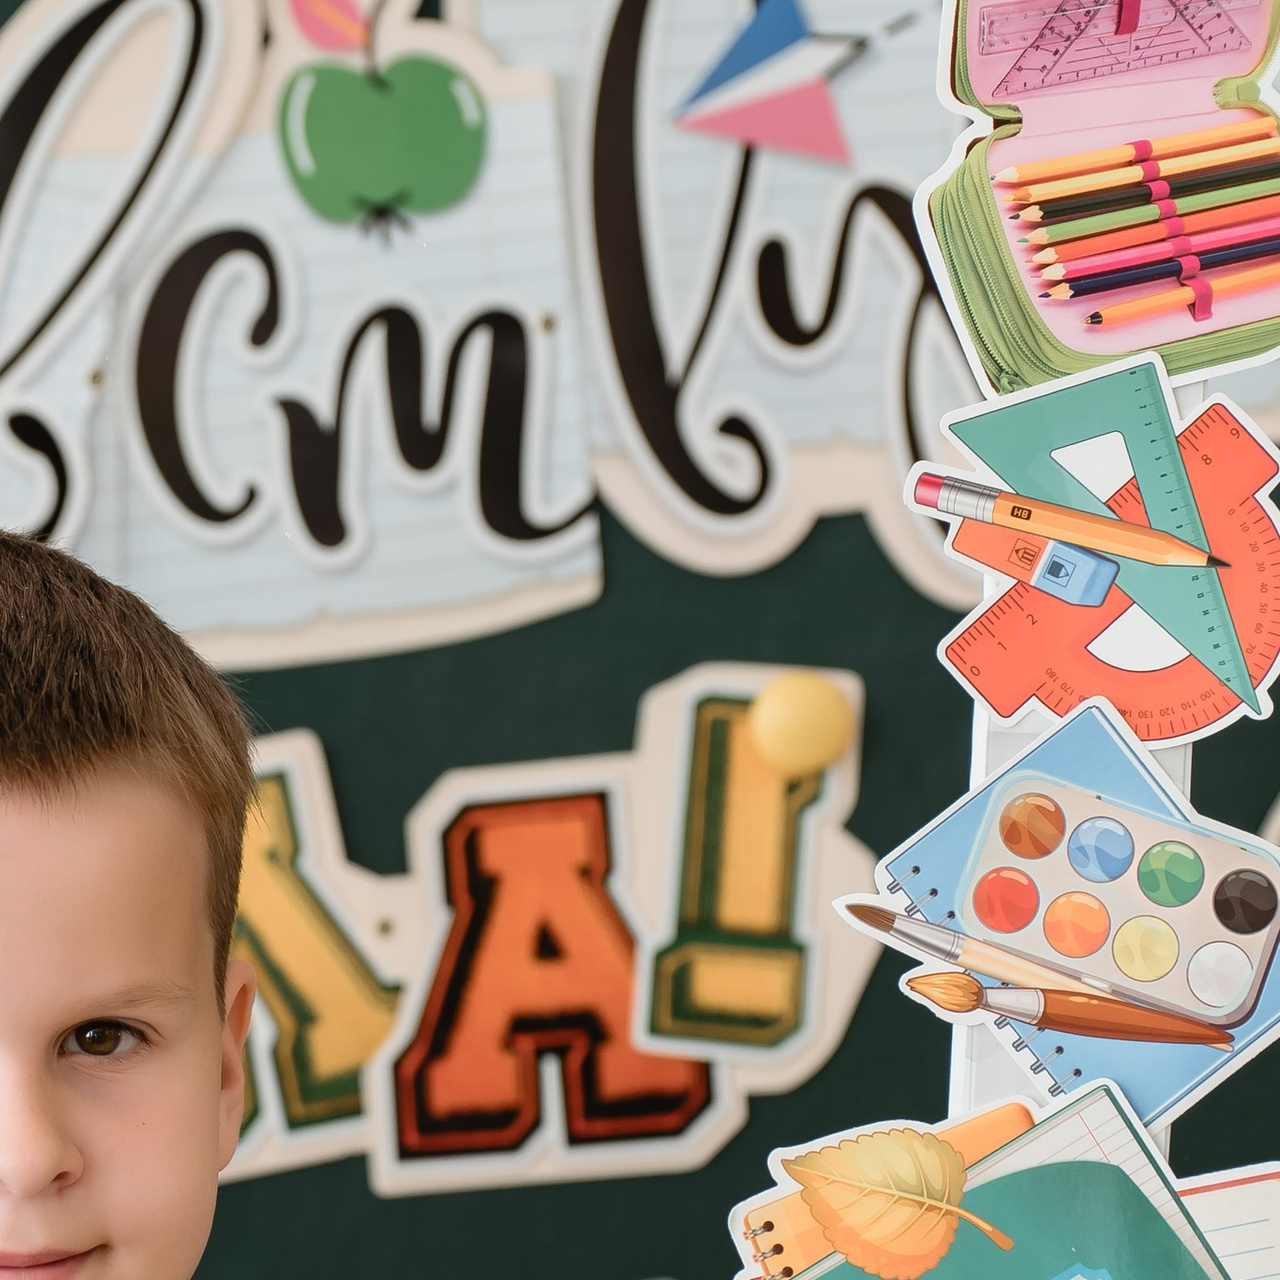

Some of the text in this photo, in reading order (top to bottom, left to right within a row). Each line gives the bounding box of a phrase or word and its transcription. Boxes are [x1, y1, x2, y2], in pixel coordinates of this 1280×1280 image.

[970, 666, 981, 676] 0
[1026, 614, 1038, 625] 2
[1201, 455, 1212, 465] 8
[1230, 428, 1240, 439] 9
[1257, 562, 1265, 572] 30
[1260, 583, 1268, 593] 40
[1260, 603, 1268, 613] 50
[1254, 623, 1263, 634] 60
[1246, 643, 1256, 654] 70
[1138, 710, 1154, 718] 130
[1160, 707, 1175, 716] 120
